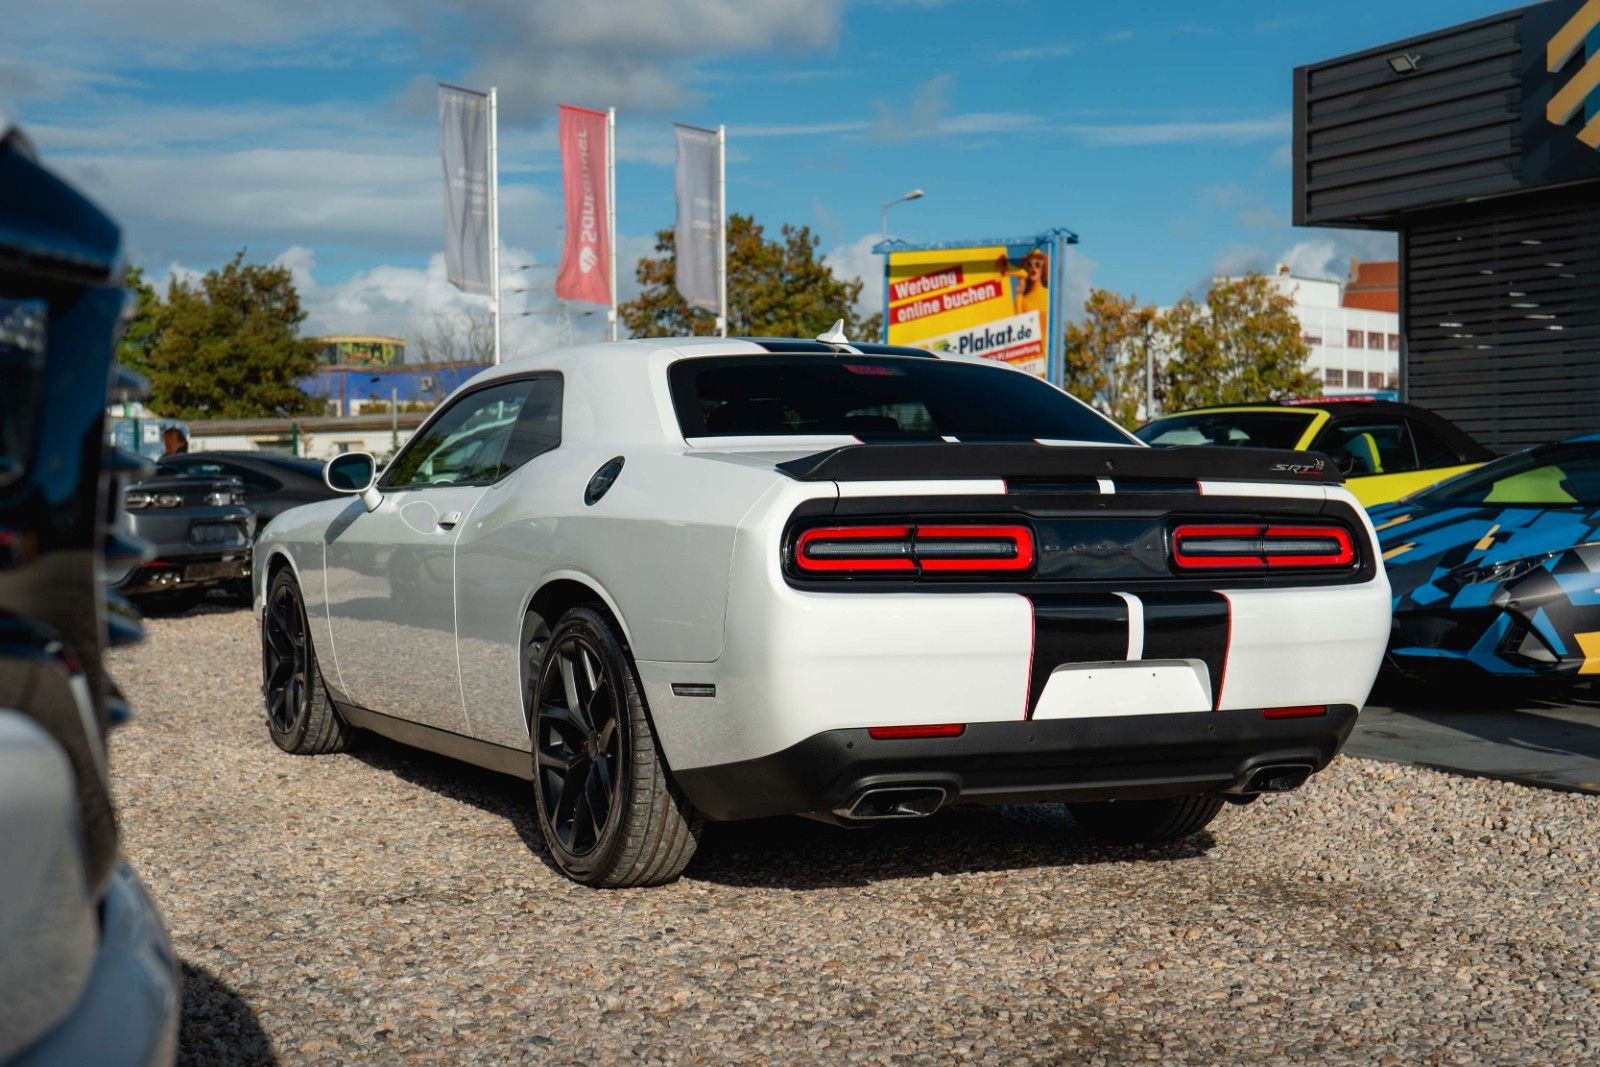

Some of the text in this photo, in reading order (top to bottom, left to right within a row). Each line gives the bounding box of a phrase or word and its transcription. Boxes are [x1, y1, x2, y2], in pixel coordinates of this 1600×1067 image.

[894, 271, 958, 299] Werbung
[897, 284, 996, 322] online buchen
[1271, 463, 1315, 474] SRT
